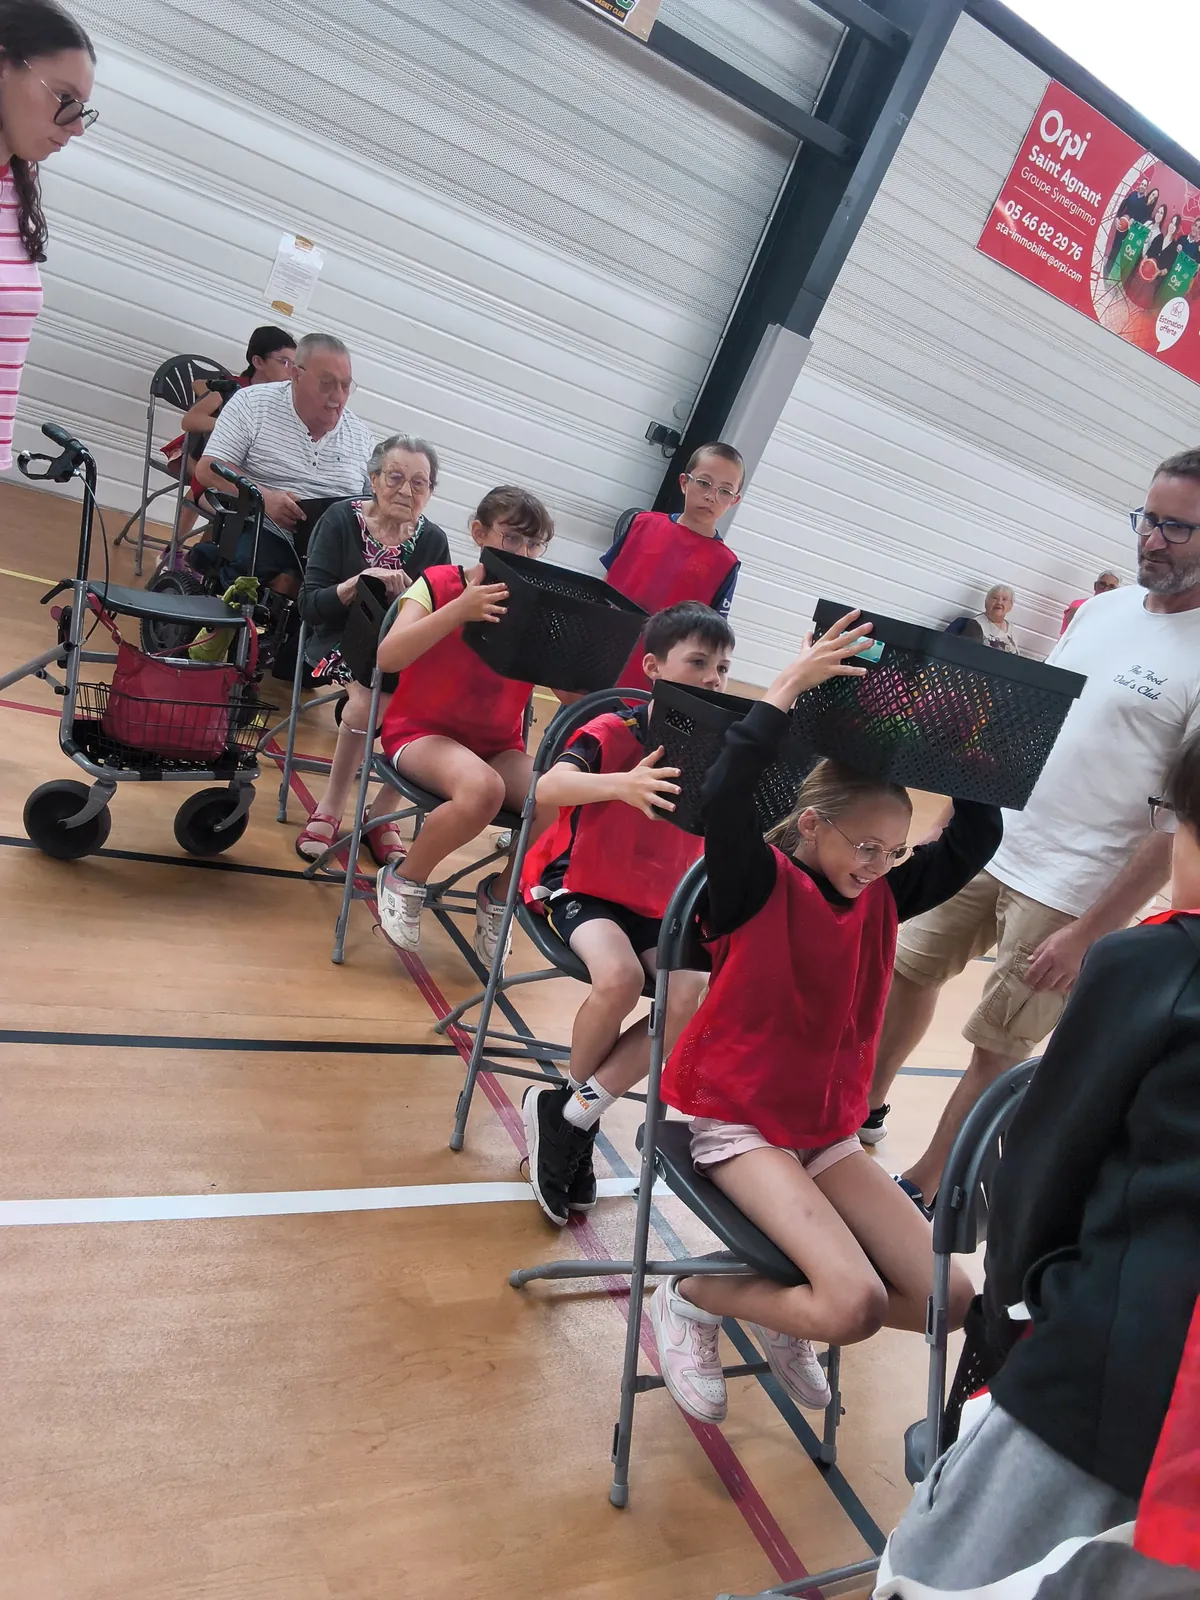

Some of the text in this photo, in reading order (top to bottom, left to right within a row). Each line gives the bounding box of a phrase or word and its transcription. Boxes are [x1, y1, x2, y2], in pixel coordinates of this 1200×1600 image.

[612, 6, 625, 18] CLUB
[1040, 109, 1091, 161] Orpi
[1028, 145, 1102, 208] Saint Agnant
[1021, 166, 1097, 227] Groupe Synergimmo
[1004, 200, 1083, 261] 05 46 82 29 76
[995, 222, 1083, 283] sta-immobilier@orpi.com
[1159, 315, 1184, 330] Estimation
[1159, 325, 1177, 337] offerte
[1128, 664, 1168, 686] The Food
[1137, 685, 1161, 701] Club
